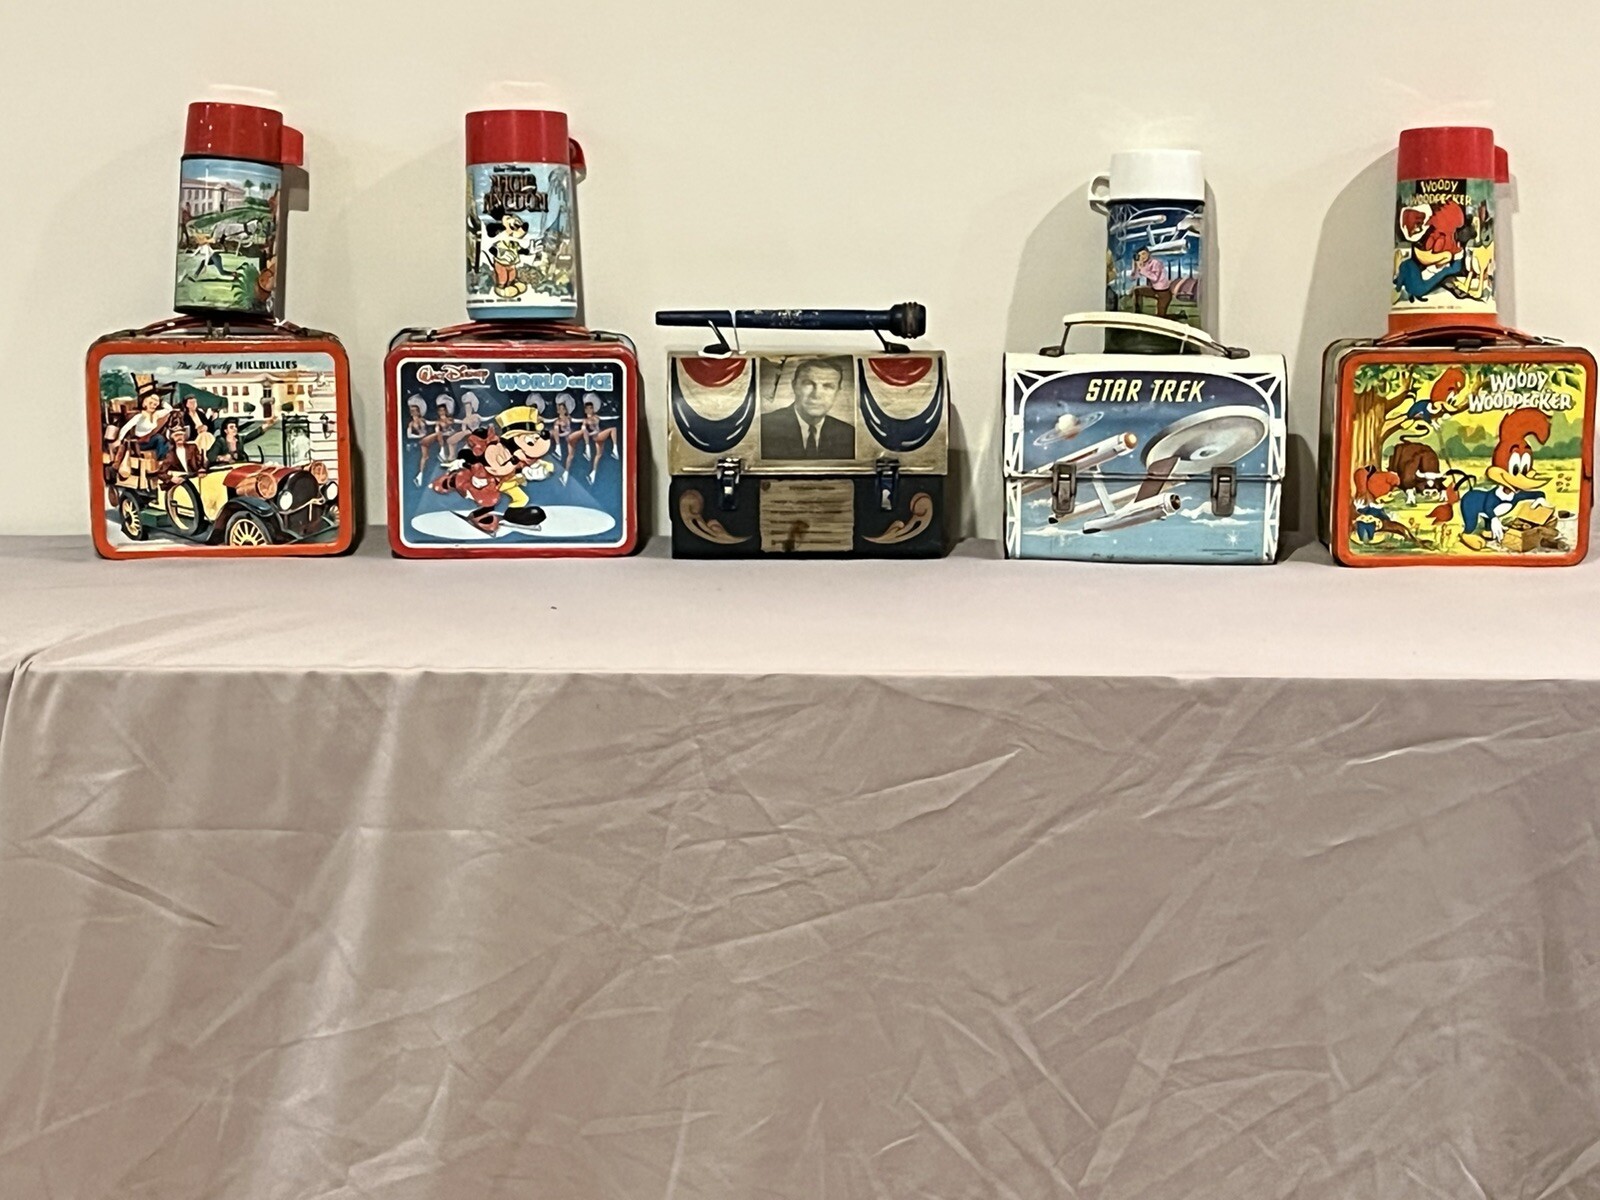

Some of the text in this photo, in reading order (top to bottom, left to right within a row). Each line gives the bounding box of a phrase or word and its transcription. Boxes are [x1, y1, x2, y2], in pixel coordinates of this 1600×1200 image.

[1420, 179, 1459, 194] WOODY
[176, 360, 192, 370] The
[235, 360, 298, 370] HILLBILLIES
[495, 372, 569, 391] WORLD
[584, 372, 614, 391] ICE
[1085, 378, 1206, 403] STAR TREK
[1489, 370, 1549, 393] WOODY
[1467, 391, 1573, 413] WOODPECKER
